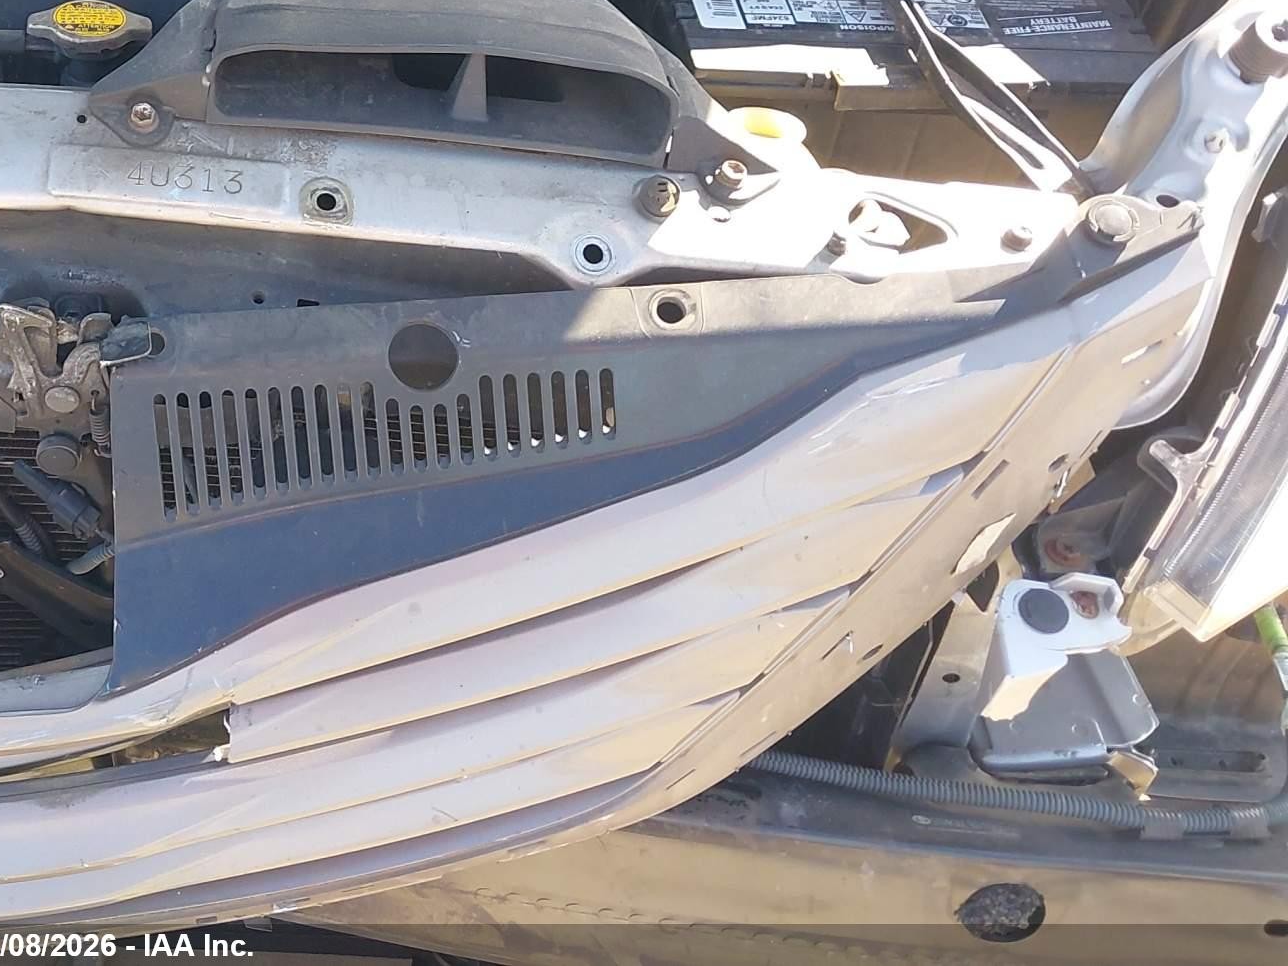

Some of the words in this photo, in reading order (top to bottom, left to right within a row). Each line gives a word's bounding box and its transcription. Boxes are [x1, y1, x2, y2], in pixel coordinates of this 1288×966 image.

[1002, 19, 1111, 35] MAINTENANCE-FREE
[1030, 16, 1077, 25] BATTERY
[127, 161, 243, 194] 4U313
